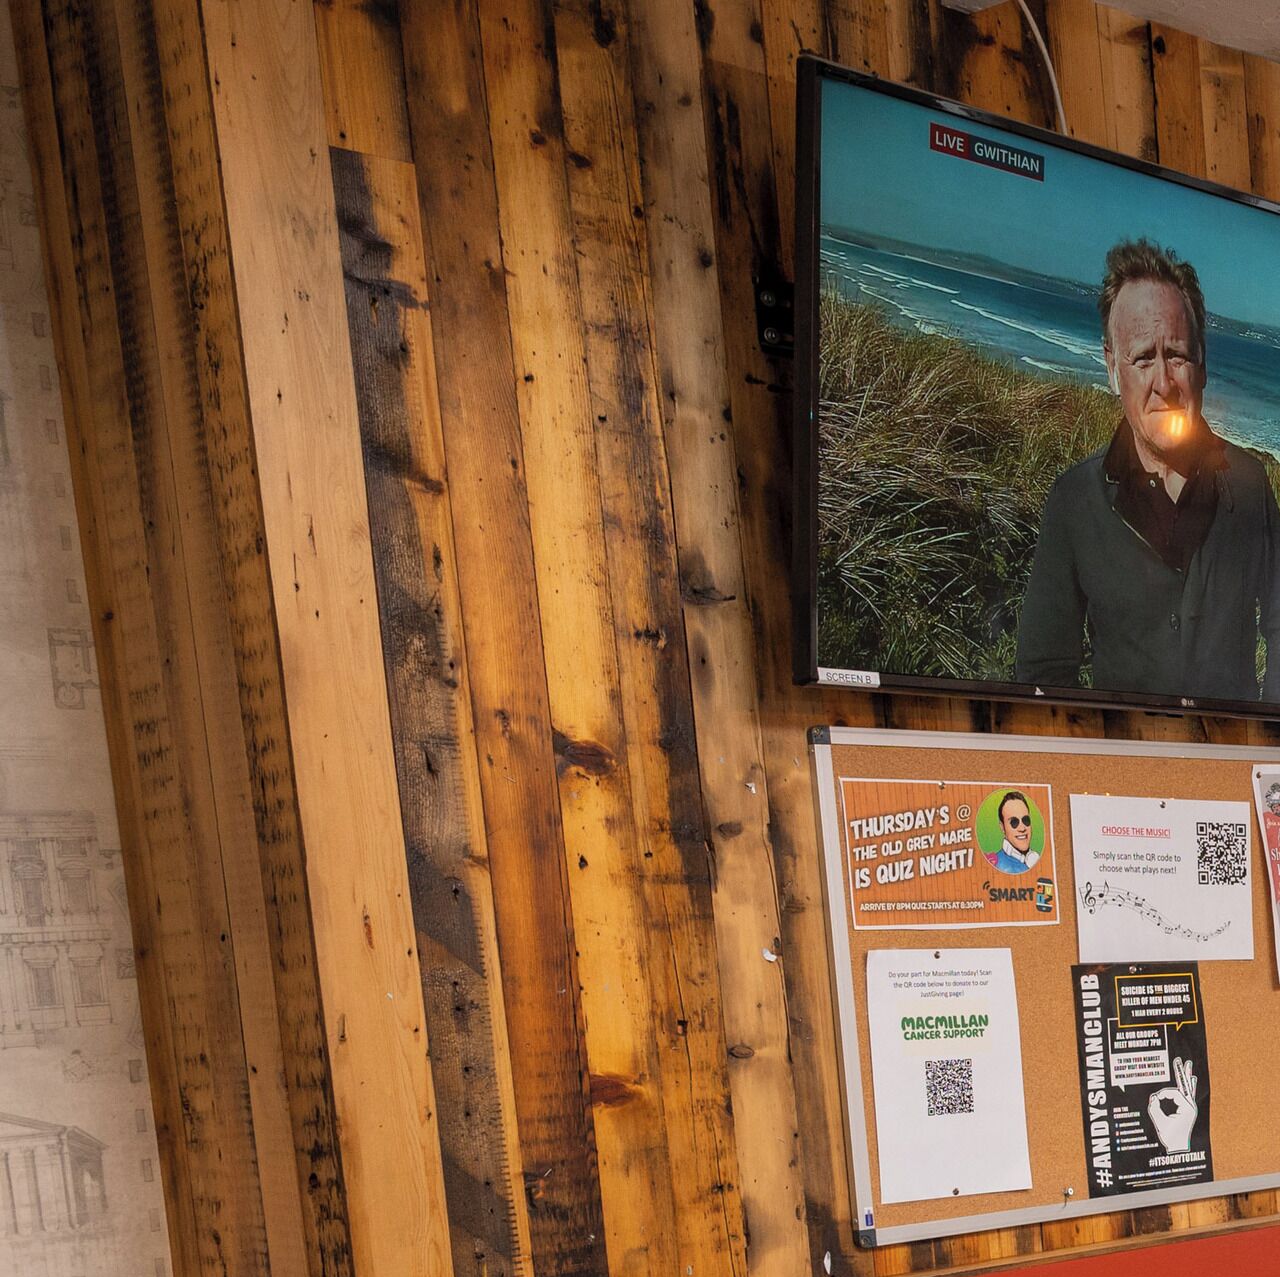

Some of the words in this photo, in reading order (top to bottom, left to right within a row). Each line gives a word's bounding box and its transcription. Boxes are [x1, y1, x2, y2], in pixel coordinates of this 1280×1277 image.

[935, 131, 965, 152] LIVE
[974, 142, 1040, 173] GWITHIAN
[826, 672, 863, 683] SCREEN
[865, 675, 872, 684] B
[850, 805, 950, 840] THURSDAY'S
[956, 804, 972, 822] @
[1102, 826, 1130, 837] CHOOSE
[1132, 827, 1145, 837] THE
[1146, 828, 1171, 838] MUSIC!
[853, 844, 878, 862] THE
[881, 840, 903, 857] OLD
[906, 834, 935, 853] GREY
[939, 827, 972, 846] MARE
[1093, 851, 1115, 862] Simply
[1117, 852, 1131, 860] scan
[1133, 852, 1145, 861] the
[1146, 854, 1157, 862] QR
[1157, 853, 1173, 862] code
[855, 867, 871, 889] IS
[876, 859, 914, 885] QUIZ
[919, 848, 974, 877] NIGHT!
[1099, 864, 1123, 873] choose
[1124, 865, 1141, 874] what
[1142, 866, 1159, 876] plays
[1160, 866, 1177, 875] next!
[989, 888, 1035, 902] SMART
[860, 903, 886, 911] ARRIVE
[887, 903, 896, 911] BY
[896, 902, 911, 911] 8PM
[912, 902, 928, 911] QUIZ
[928, 901, 952, 910] STARTS
[952, 901, 960, 910] AT
[960, 901, 984, 910] 8:30PM
[1121, 985, 1146, 996] SUICIDE
[1146, 985, 1154, 995] IS
[1164, 983, 1190, 993] BIGGEST
[1122, 996, 1141, 1006] KILLER
[1141, 996, 1149, 1005] OF
[1149, 996, 1162, 1005] MEN
[1163, 994, 1182, 1004] UNDER
[1182, 994, 1190, 1003] 45
[1146, 1008, 1161, 1016] EVERY
[901, 1014, 989, 1031] MACMILLAN
[904, 1030, 941, 1040] CANCER
[943, 1028, 985, 1039] SUPPORT
[1116, 1032, 1125, 1040] ALL
[1080, 974, 1113, 1188] #ANDYSMANCLUB
[1149, 1151, 1206, 1168] #ITSOKAYTOTALK
